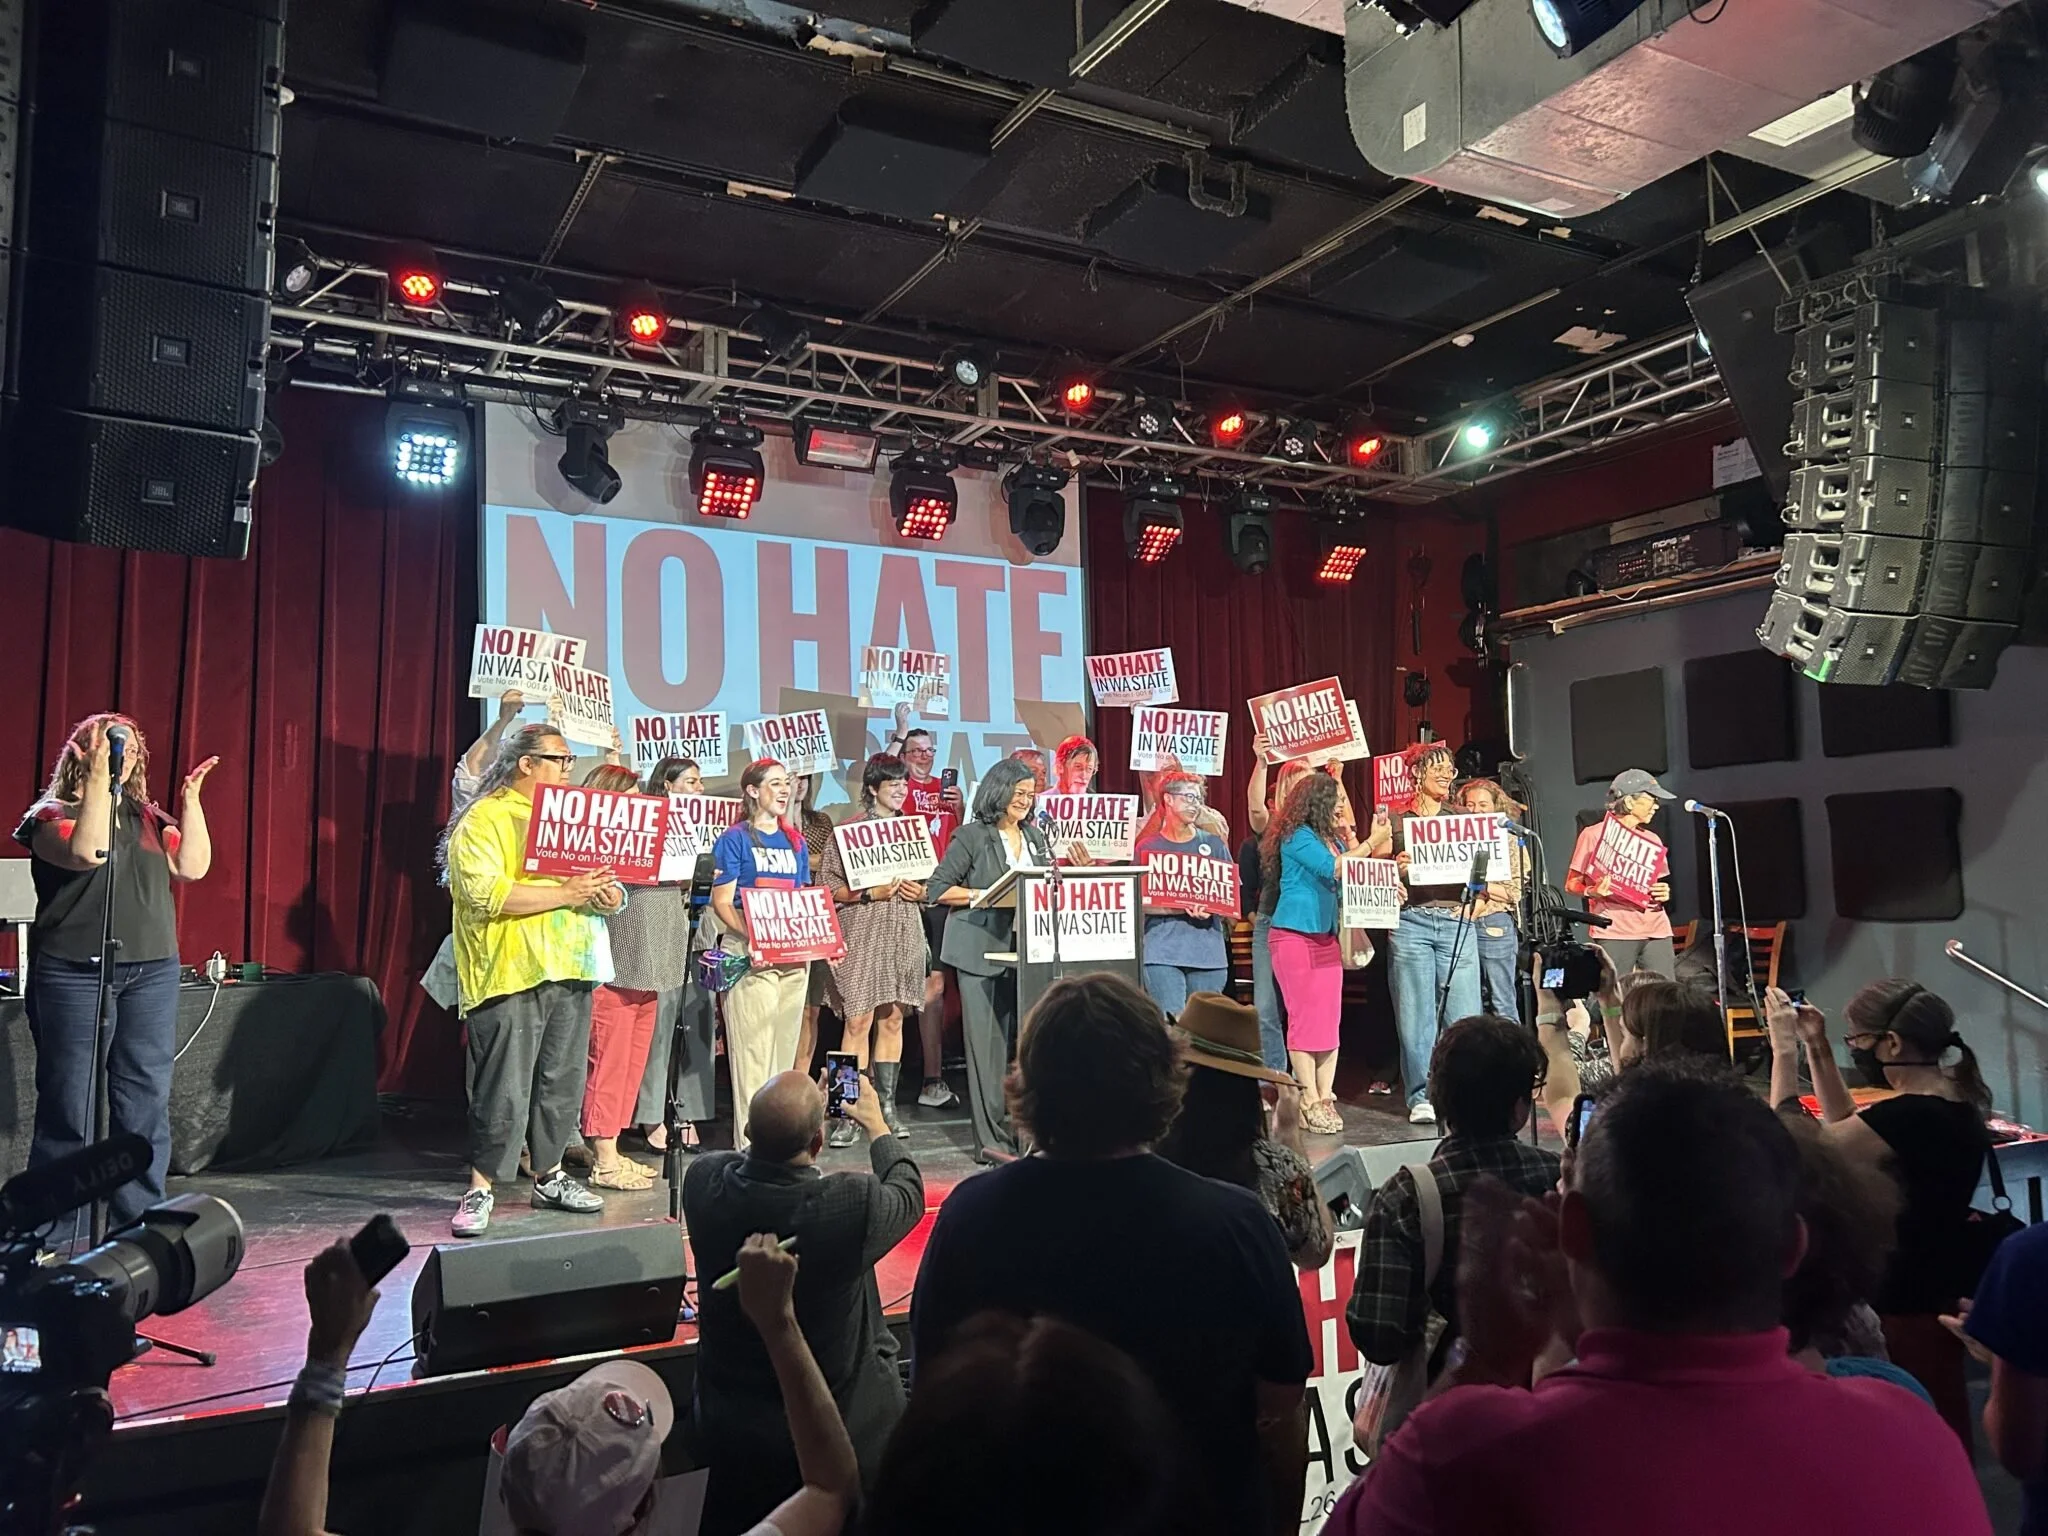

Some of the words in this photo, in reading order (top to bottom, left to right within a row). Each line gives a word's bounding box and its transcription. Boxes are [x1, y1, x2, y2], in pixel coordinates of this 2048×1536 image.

[506, 514, 724, 712] NO
[758, 540, 1068, 722] HATE
[481, 628, 514, 655] NO
[517, 632, 578, 665] HTE
[478, 655, 494, 676] IN
[498, 656, 522, 678] WA
[866, 648, 895, 672] NO
[899, 651, 945, 678] HATE
[1091, 657, 1118, 677] NO
[1118, 652, 1167, 676] HATE
[477, 676, 494, 685] Vote
[496, 677, 506, 685] No
[551, 661, 572, 692] NO
[574, 669, 610, 704] HATE
[866, 671, 879, 688] IN
[906, 674, 944, 696] STATE
[1095, 677, 1109, 692] IN
[1109, 676, 1132, 692] WA
[1132, 671, 1170, 690] STATE
[566, 693, 584, 718] WA
[585, 698, 613, 726] STATE
[1260, 700, 1293, 728] NO
[1291, 688, 1340, 720] HATE
[635, 717, 666, 741] NO
[670, 714, 721, 739] HATE
[751, 720, 781, 745] NO
[781, 712, 825, 739] HATE
[1140, 710, 1168, 734] NO
[1172, 712, 1221, 737] HATE
[1266, 724, 1284, 746] IN
[1282, 720, 1309, 742] WA
[1307, 710, 1345, 735] STATE
[636, 740, 653, 761] IN
[654, 739, 680, 760] WA
[682, 737, 722, 758] STATE
[772, 741, 797, 760] WA
[796, 735, 830, 756] STATE
[1138, 733, 1153, 751] IN
[1155, 734, 1178, 754] WA
[1180, 737, 1219, 756] STATE
[1379, 755, 1403, 780] NO
[1380, 779, 1392, 796] IN
[1393, 776, 1412, 793] WA
[541, 788, 586, 825] NO
[588, 793, 662, 833] HATE
[1046, 797, 1074, 820] NO
[1077, 797, 1130, 820] HATE
[667, 811, 691, 835] ATE
[842, 825, 874, 850] NO
[875, 818, 925, 844] HATE
[1061, 821, 1083, 839] WA
[1086, 820, 1129, 840] STATE
[1411, 819, 1441, 844] NO
[1445, 816, 1500, 842] HATE
[536, 821, 561, 849] IN
[563, 824, 596, 853] WA
[599, 828, 658, 859] STATE
[1602, 816, 1622, 847] NO
[1614, 828, 1662, 871] HATE
[535, 848, 558, 859] Vote
[561, 851, 576, 860] No
[578, 854, 591, 862] on
[593, 854, 617, 865] I-001
[619, 857, 626, 866] &
[628, 857, 654, 868] I-638
[848, 850, 866, 869] IN
[865, 846, 892, 866] WA
[891, 841, 931, 862] STATE
[1413, 845, 1428, 864] IN
[1430, 844, 1456, 863] WA
[1148, 853, 1179, 874] NO
[1182, 855, 1234, 885] HATE
[1347, 860, 1365, 885] NO
[1368, 861, 1397, 887] HATE
[1612, 854, 1654, 889] STATE
[1034, 883, 1065, 912] NO
[1071, 882, 1126, 911] HATE
[1148, 873, 1164, 891] IN
[1165, 874, 1191, 893] WA
[1192, 877, 1234, 901] STATE
[1190, 893, 1208, 901] I-001
[1347, 886, 1357, 906] IN
[1358, 886, 1373, 906] WA
[1374, 887, 1397, 907] STATE
[746, 891, 775, 919] NO
[774, 889, 830, 918] HATE
[752, 918, 768, 941] IN
[766, 918, 792, 941] WA
[790, 915, 835, 941] STATE
[1034, 913, 1050, 936] IN
[1082, 912, 1127, 935] STATE
